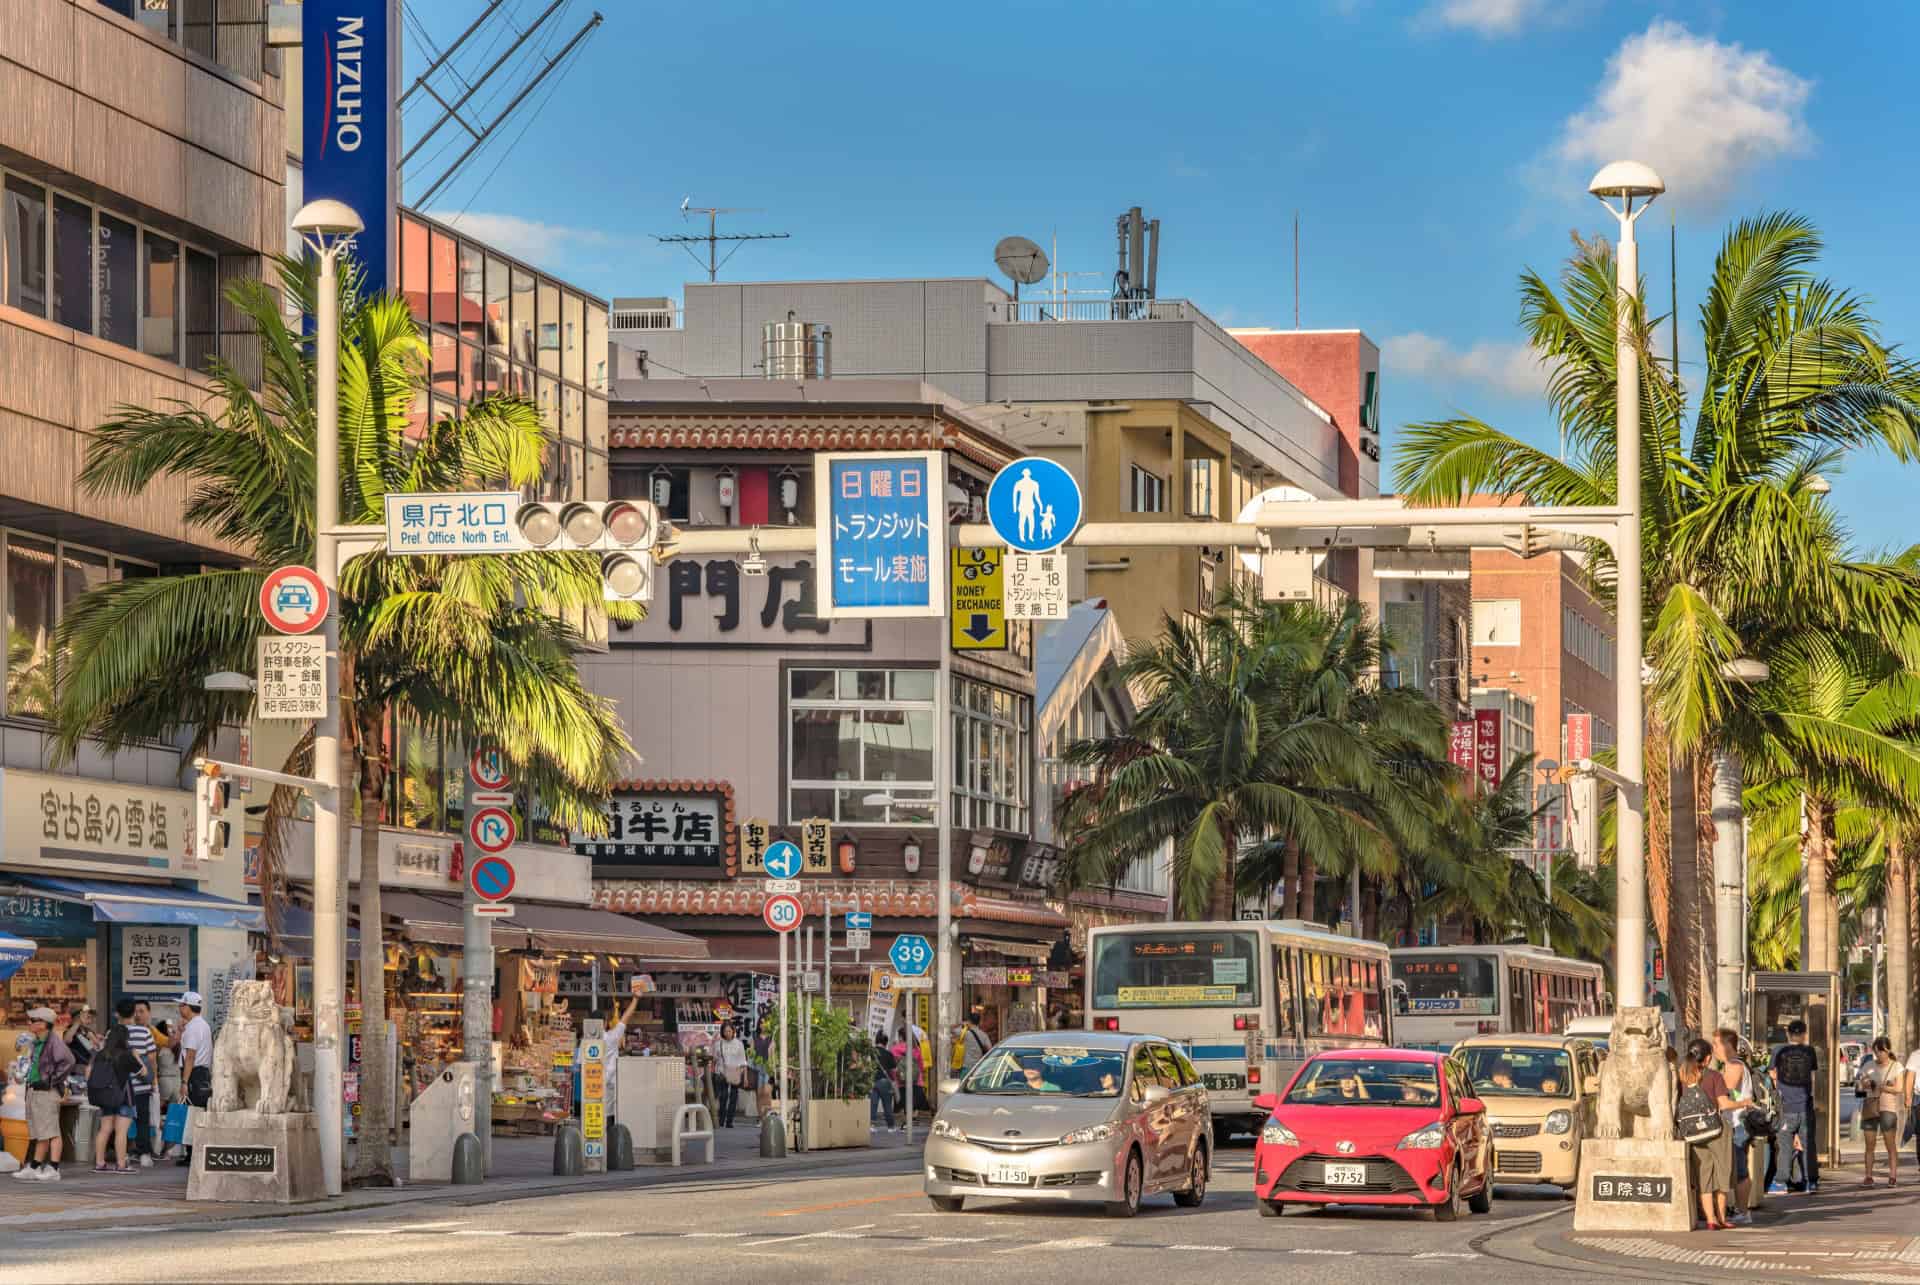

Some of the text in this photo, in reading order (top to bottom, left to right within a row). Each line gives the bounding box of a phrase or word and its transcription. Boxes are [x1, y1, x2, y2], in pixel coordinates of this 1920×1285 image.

[336, 16, 364, 152] MIZUHO
[841, 469, 921, 498] 日曜日
[402, 503, 506, 528] 県庁北口
[835, 511, 928, 541] トランジット
[427, 529, 456, 545] Office
[462, 530, 487, 544] North
[839, 554, 927, 584] モール実施
[957, 586, 985, 597] MONEY
[957, 600, 1001, 610] EXCHANGE
[264, 656, 321, 668] 許可車を除く
[40, 788, 169, 850] 宮古島の雪塩
[773, 904, 795, 922] 30
[129, 951, 182, 977] 雪塩
[898, 945, 925, 962] 39
[1598, 1181, 1667, 1198] 国際通り
